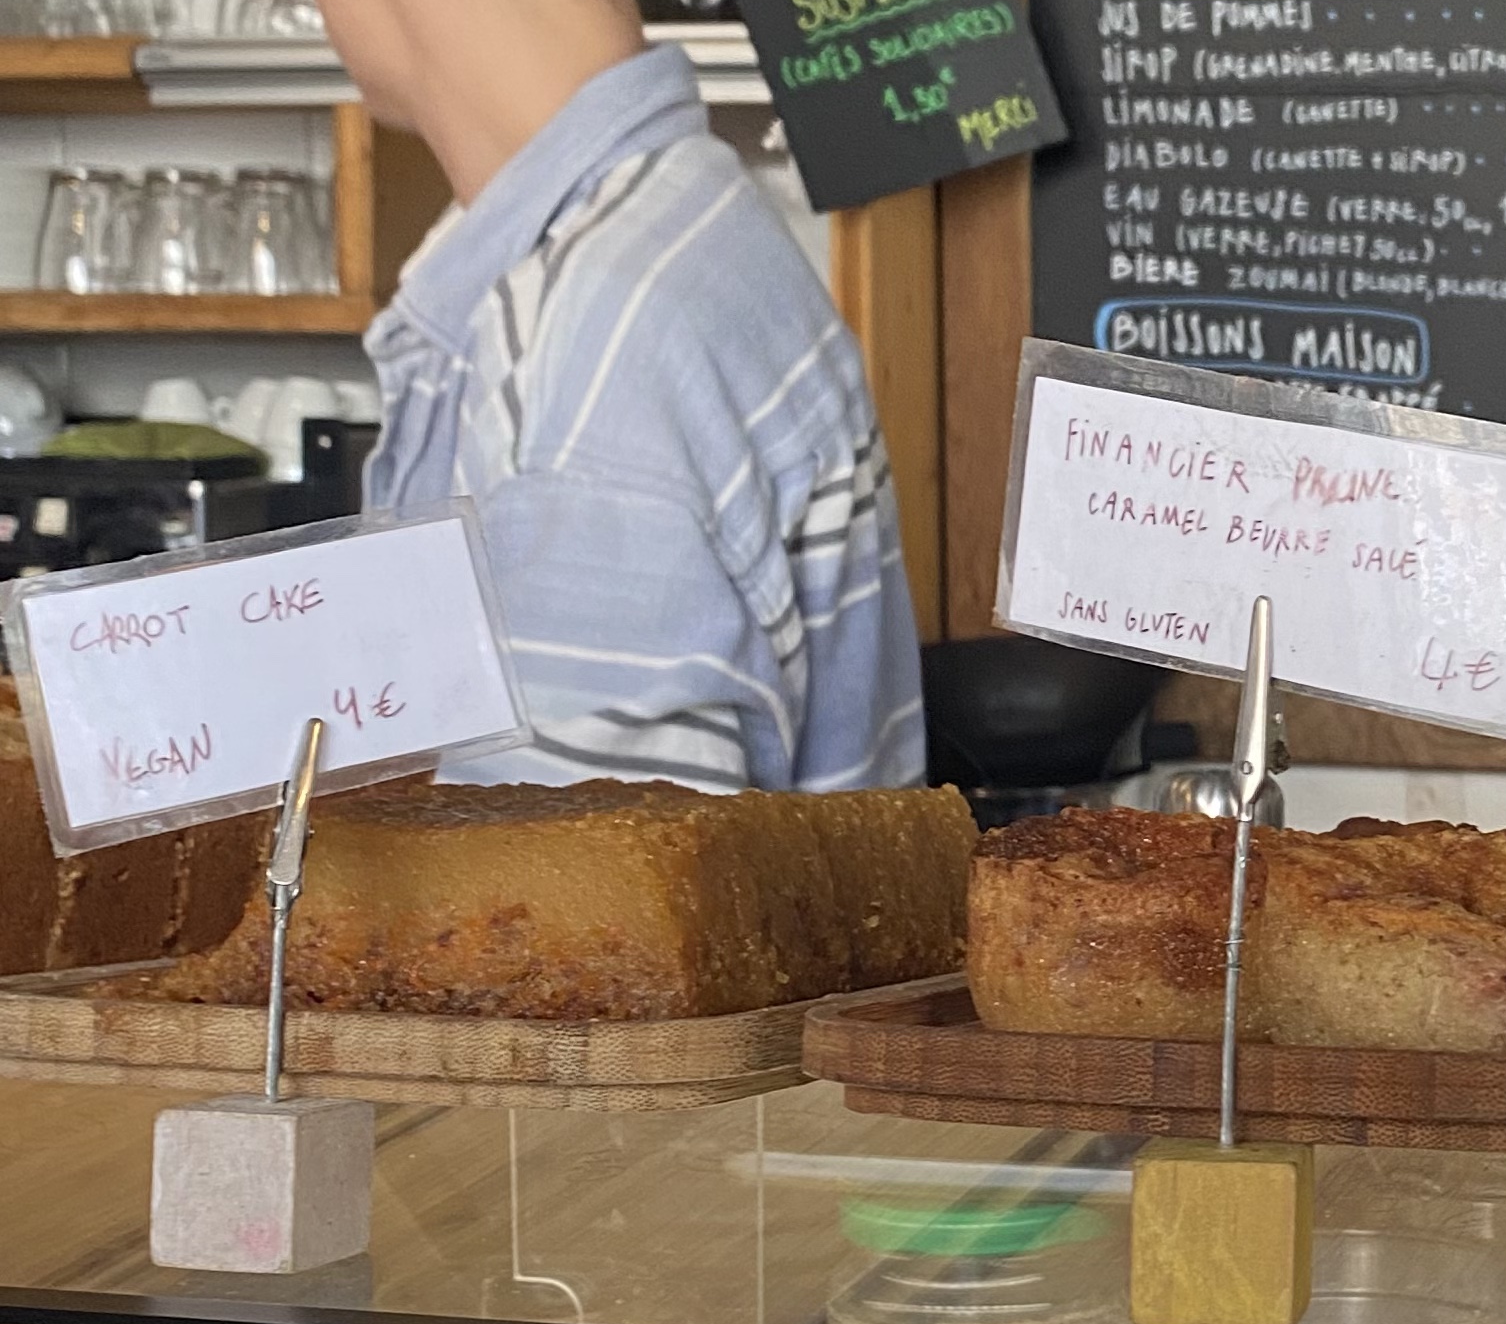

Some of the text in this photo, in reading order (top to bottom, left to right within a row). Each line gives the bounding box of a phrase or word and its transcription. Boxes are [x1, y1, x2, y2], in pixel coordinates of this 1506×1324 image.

[1161, 0, 1197, 32] DE
[1211, 0, 1313, 37] POMMES
[1101, 41, 1177, 83] SIROP
[1102, 86, 1254, 129] LIMONADE
[1105, 136, 1229, 171] DIABOLO
[1103, 181, 1160, 214] EAU
[1179, 185, 1309, 221] GAZEUSE
[1105, 214, 1154, 248] VIN
[1111, 305, 1416, 375] BOISSONS MAISON
[1064, 418, 1249, 494] FINANCIER
[1088, 491, 1207, 535] CARAMEL
[1226, 515, 1330, 556] BEURRE
[70, 577, 324, 654] CARROT CAKE
[1057, 592, 1210, 646] SANS GLUTEN
[100, 722, 211, 782] VEGAN
